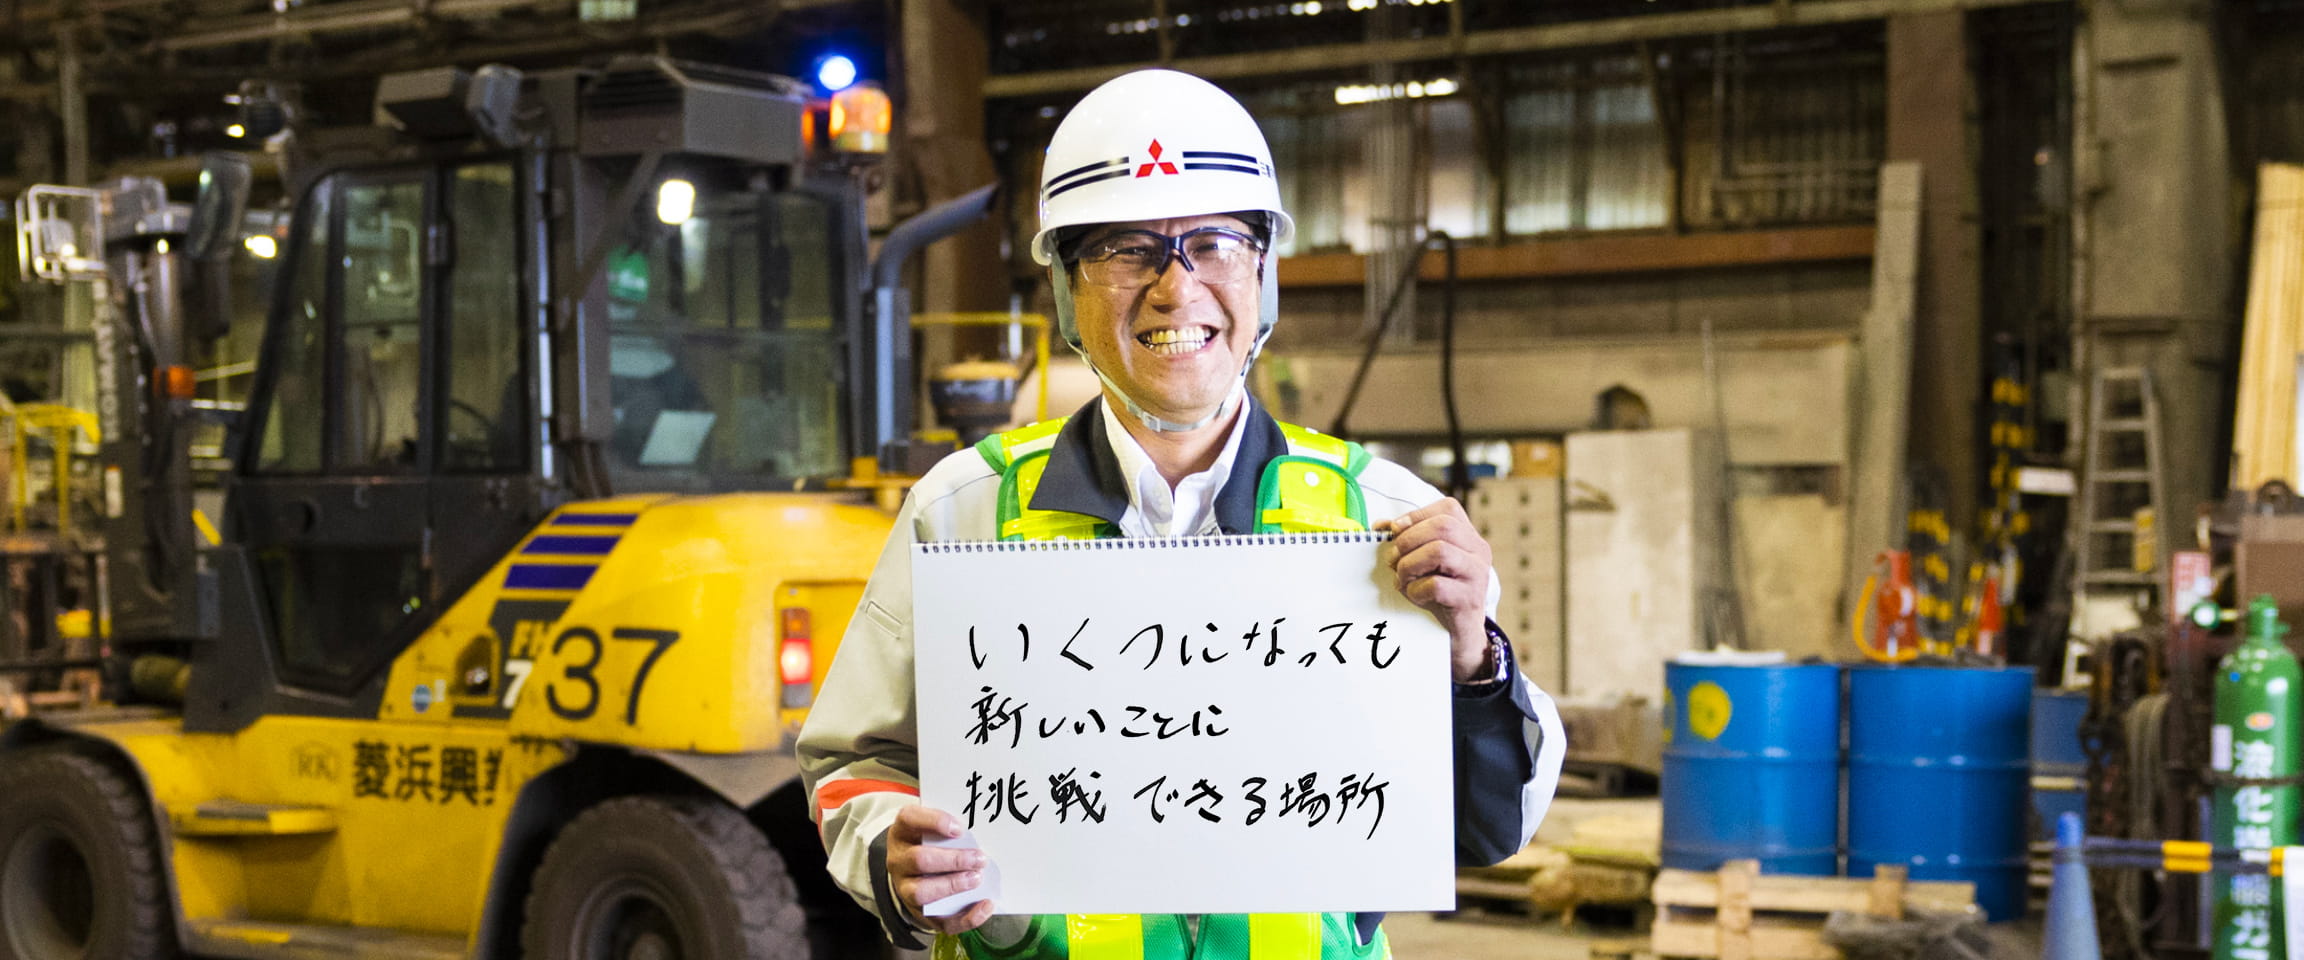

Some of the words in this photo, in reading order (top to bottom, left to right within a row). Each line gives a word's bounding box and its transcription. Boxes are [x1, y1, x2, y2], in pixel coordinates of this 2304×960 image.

[970, 618, 1400, 671] いくつになっても
[546, 626, 681, 726] 37
[965, 686, 1228, 748] 新しいことに
